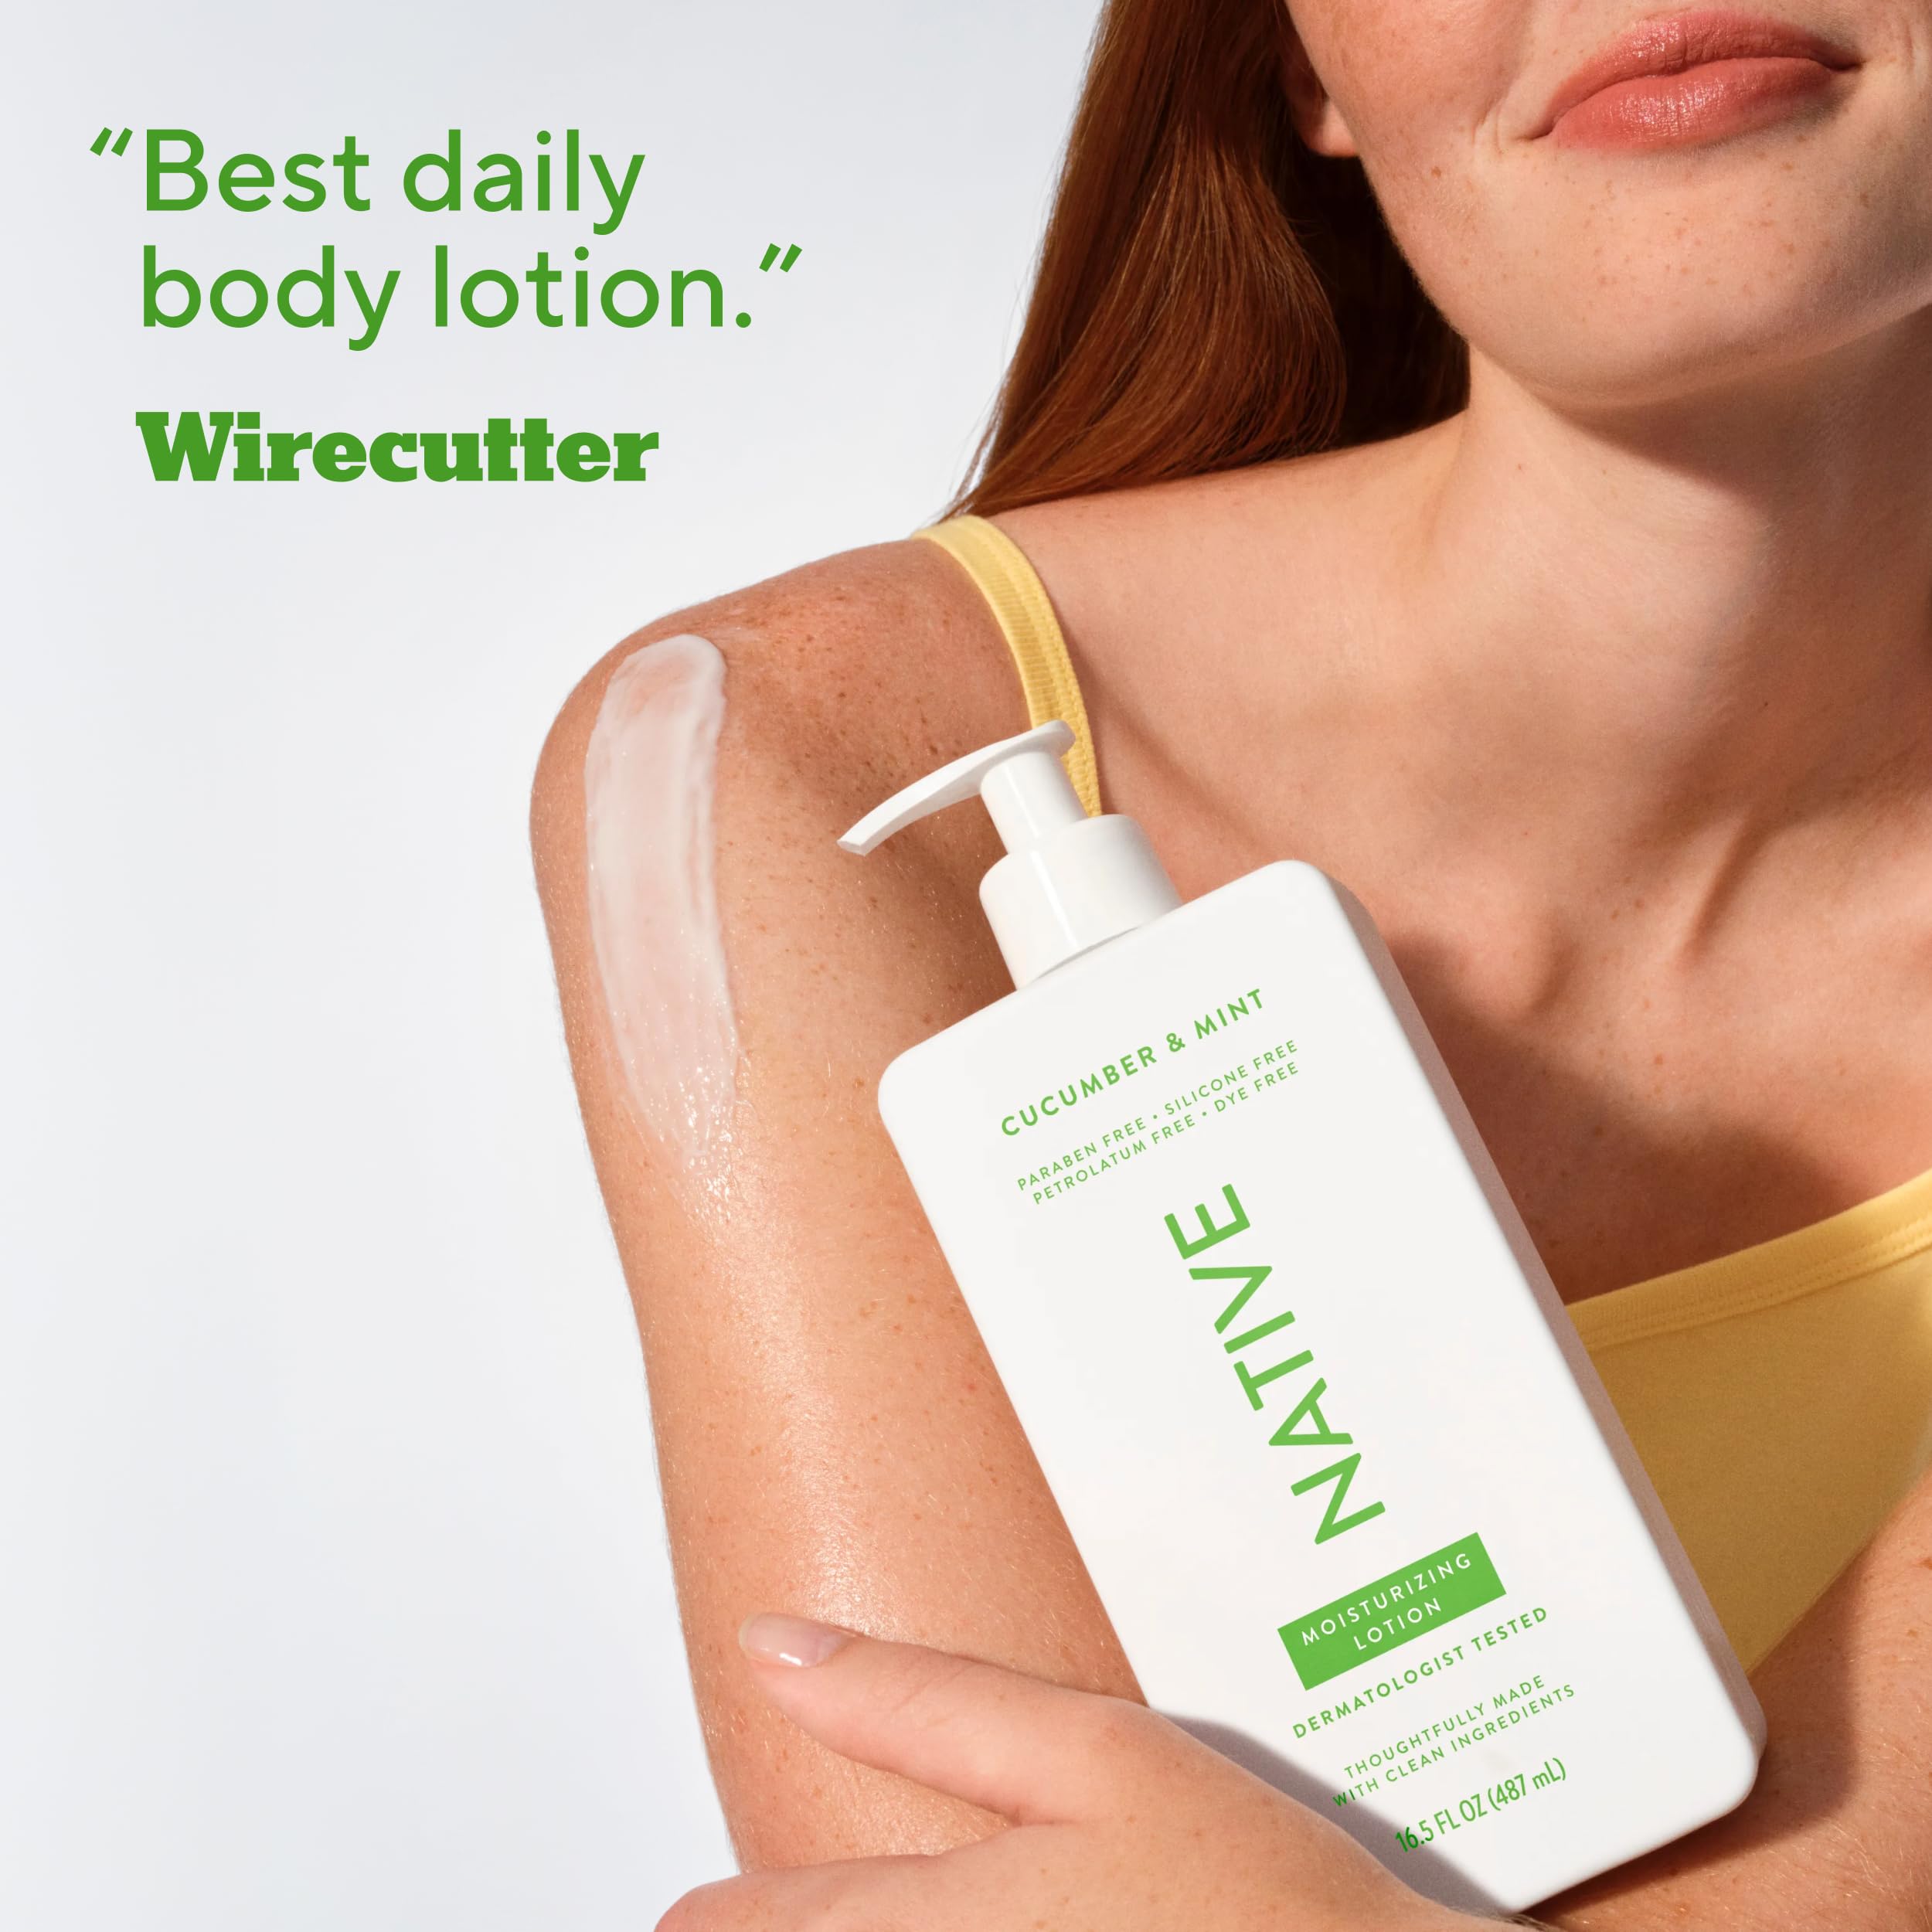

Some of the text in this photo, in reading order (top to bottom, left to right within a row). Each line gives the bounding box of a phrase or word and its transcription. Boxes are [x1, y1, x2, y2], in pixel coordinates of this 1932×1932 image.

[1001, 988, 1265, 1137] CUCUMBER & MINT
[1017, 1039, 1298, 1191] PARABEN FREE SILICONE FREE
[1032, 1061, 1299, 1205] PETROLATUM FREE DYE FREE
[1164, 1183, 1386, 1546] NATIVE
[1301, 1553, 1472, 1647] MOISTURIZING
[1352, 1597, 1443, 1651] LOTION
[1292, 1607, 1547, 1739] DERMATOLOGIST TESTED
[1344, 1675, 1546, 1779] THOUGHTFULLY MADE
[1332, 1683, 1575, 1808] WITH CLEAN INGREDIENTS
[1395, 1757, 1567, 1852] 16.5 FL OZ (487 mL)
